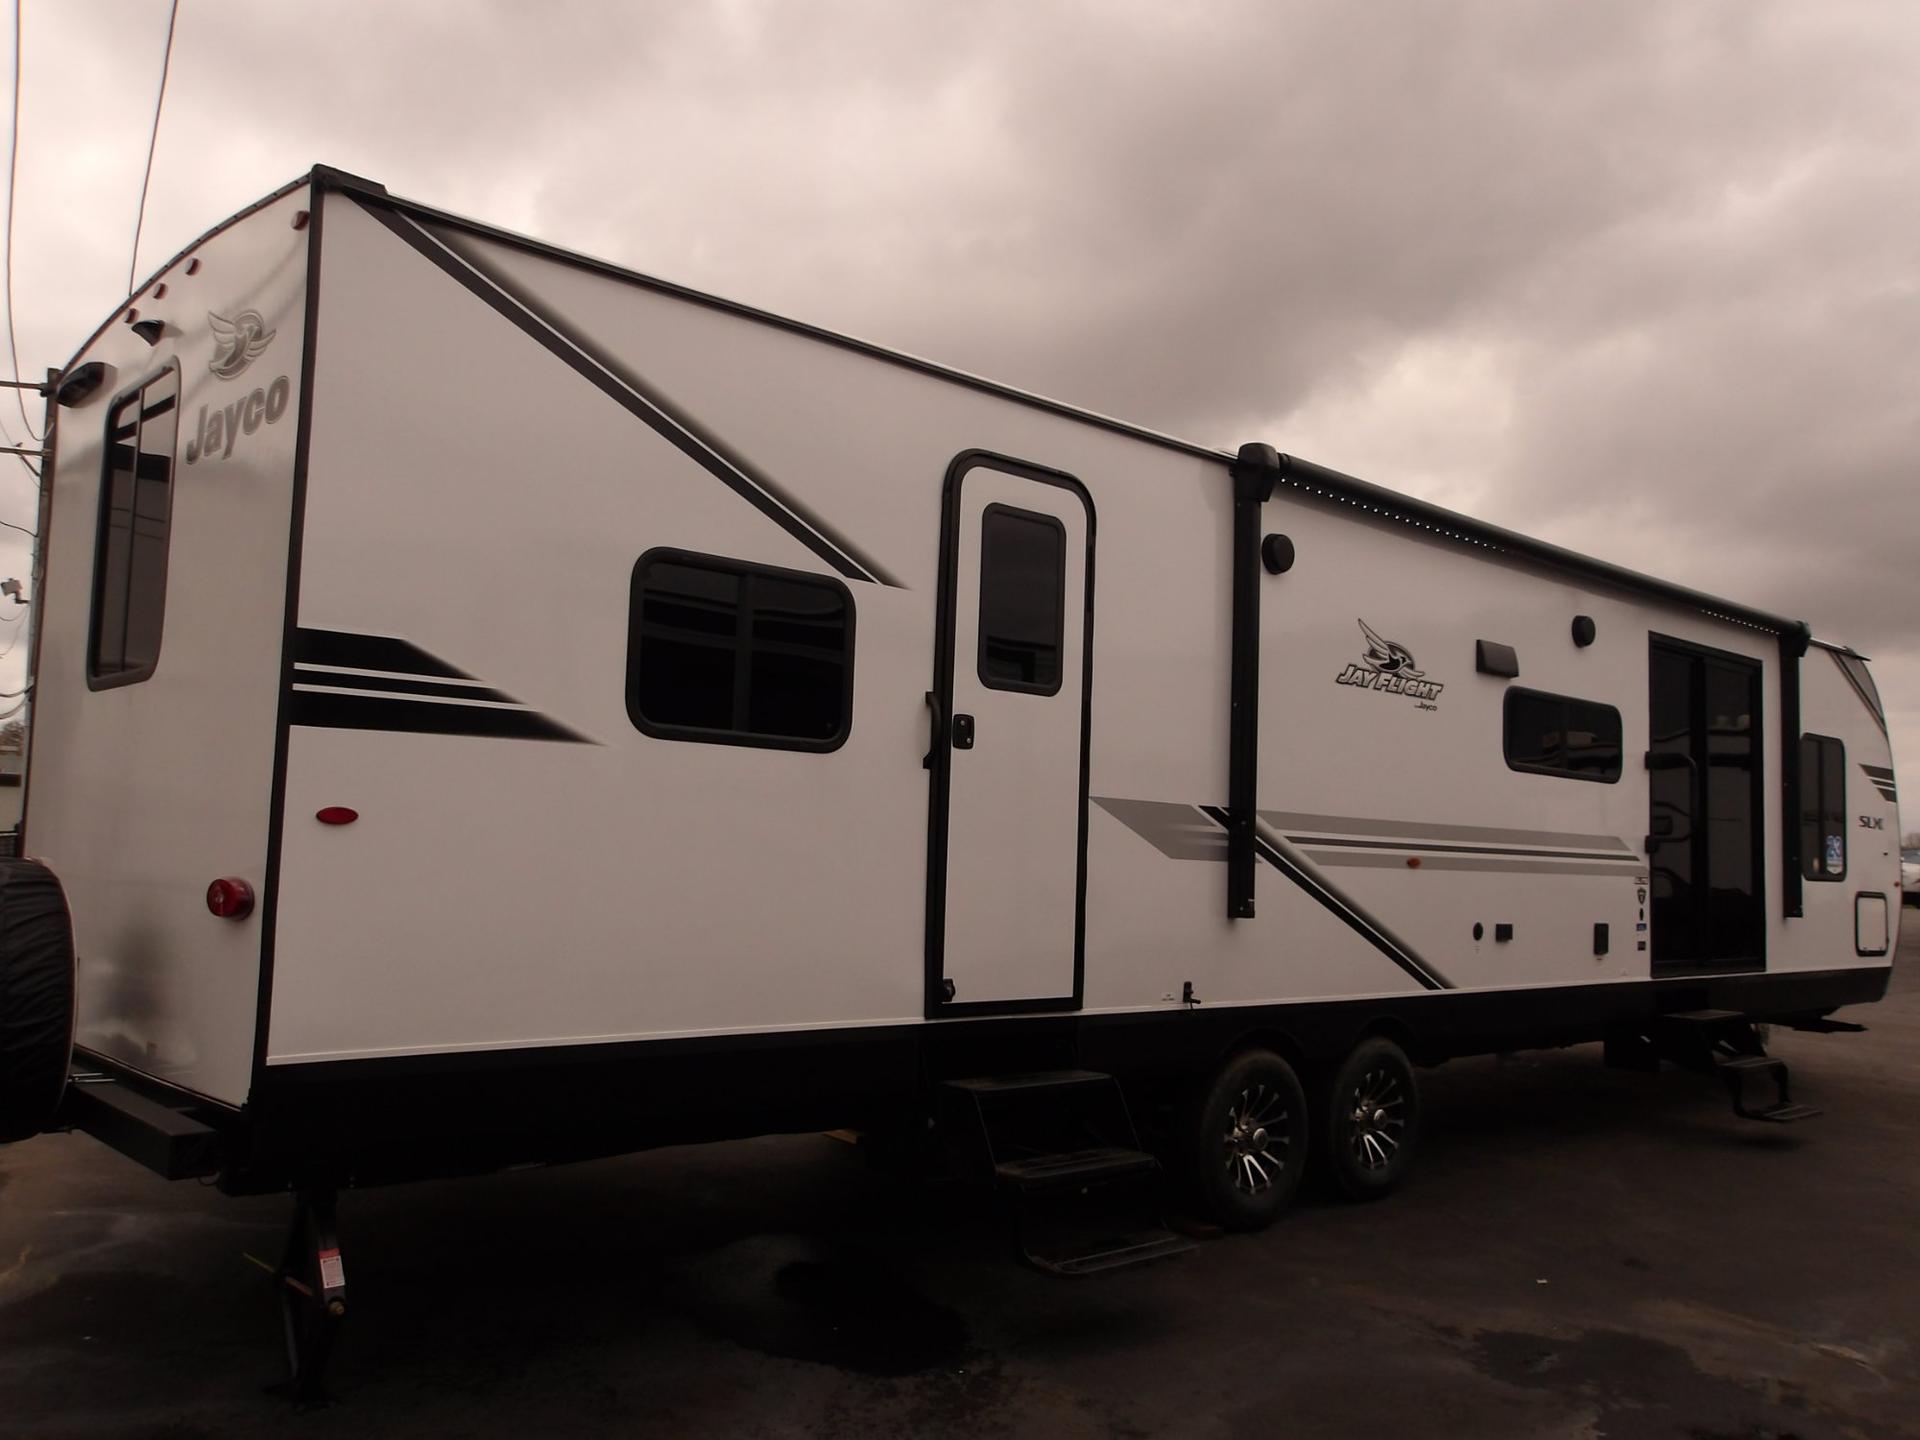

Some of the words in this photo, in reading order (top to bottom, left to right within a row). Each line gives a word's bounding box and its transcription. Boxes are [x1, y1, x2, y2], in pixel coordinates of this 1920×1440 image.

[186, 375, 290, 465] Jayco
[1335, 663, 1378, 688] JAY
[1372, 670, 1444, 701] FLIGHT
[1858, 815, 1884, 831] SLX
